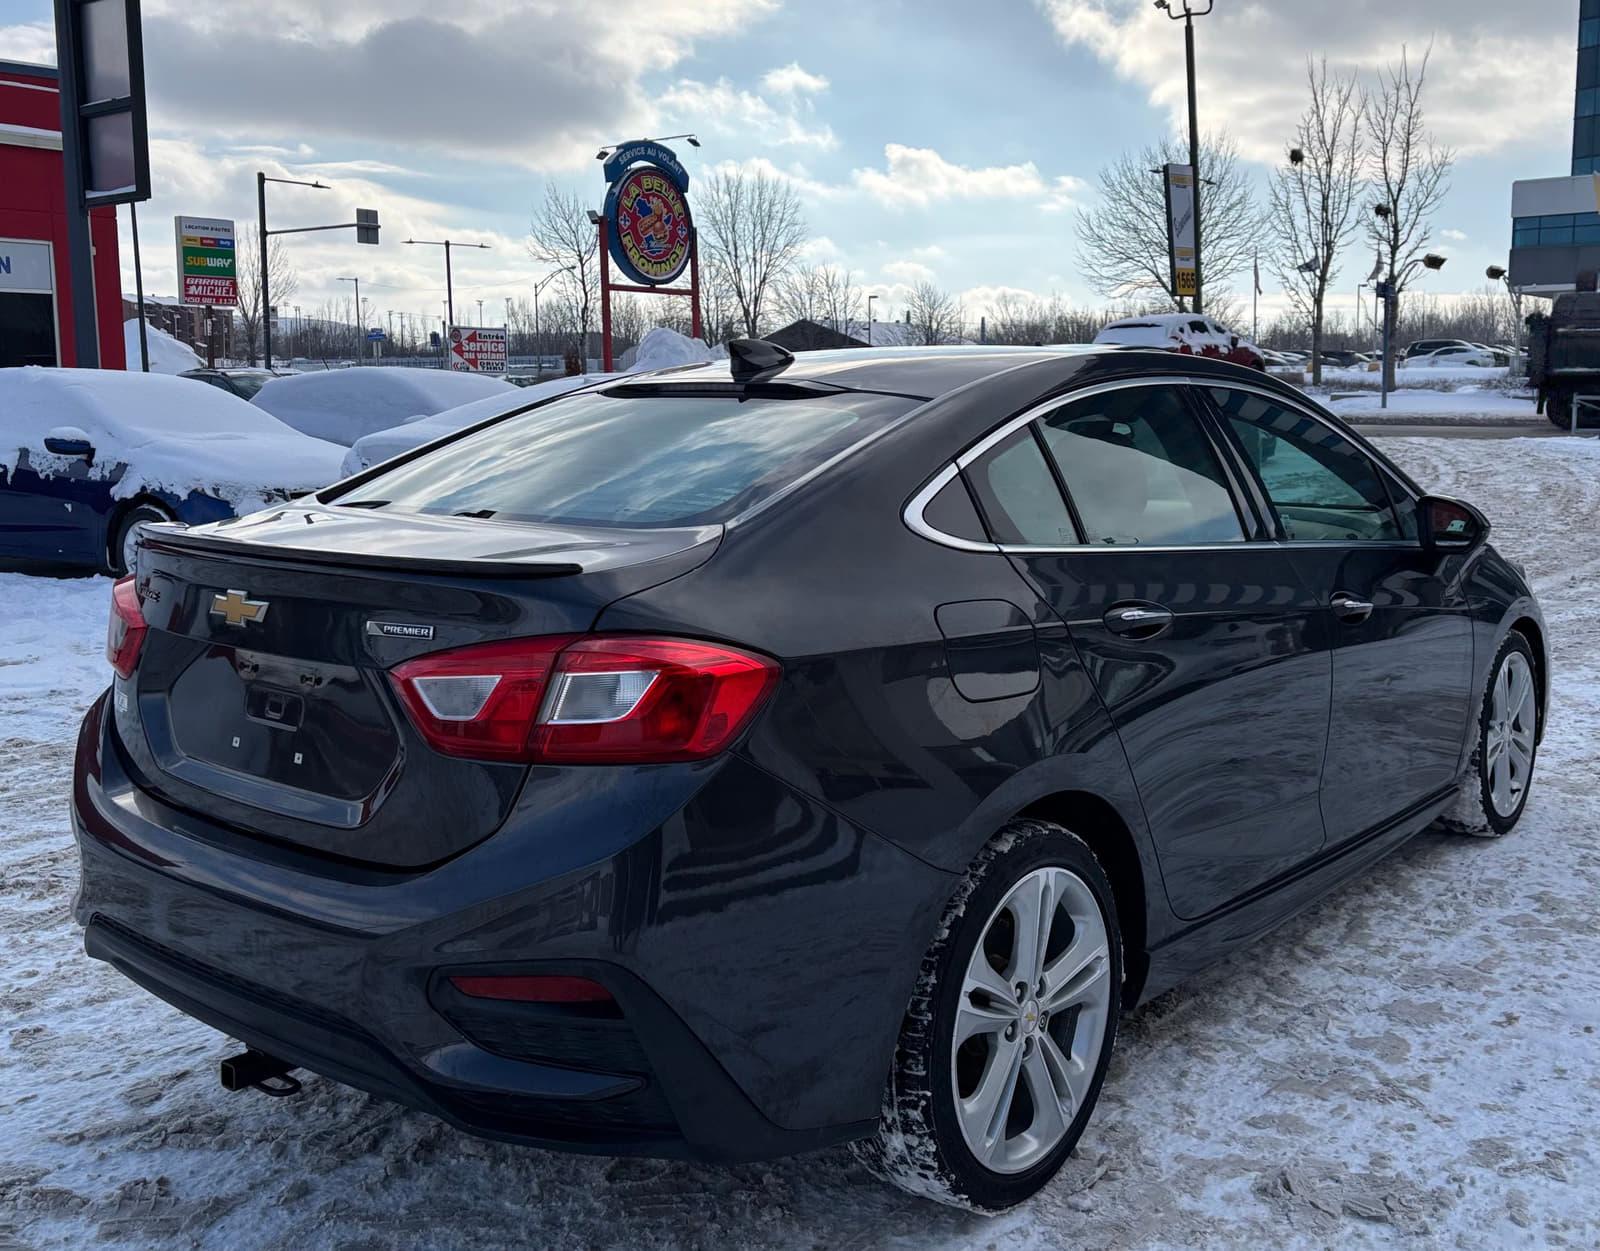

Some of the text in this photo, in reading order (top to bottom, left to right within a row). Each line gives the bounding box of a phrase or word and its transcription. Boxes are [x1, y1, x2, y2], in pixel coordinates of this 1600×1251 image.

[619, 147, 683, 175] SERVICE AU VOLANT
[622, 175, 685, 219] LA BELLE
[621, 230, 685, 274] PROVINCE
[186, 256, 232, 268] SUBWAY
[186, 278, 233, 287] GARAGE
[1177, 271, 1195, 289] 1565
[190, 285, 236, 297] MICHEL
[478, 332, 505, 340] Entrée
[462, 340, 505, 352] Service
[463, 351, 506, 360] au volant
[383, 625, 429, 636] PREMIER
